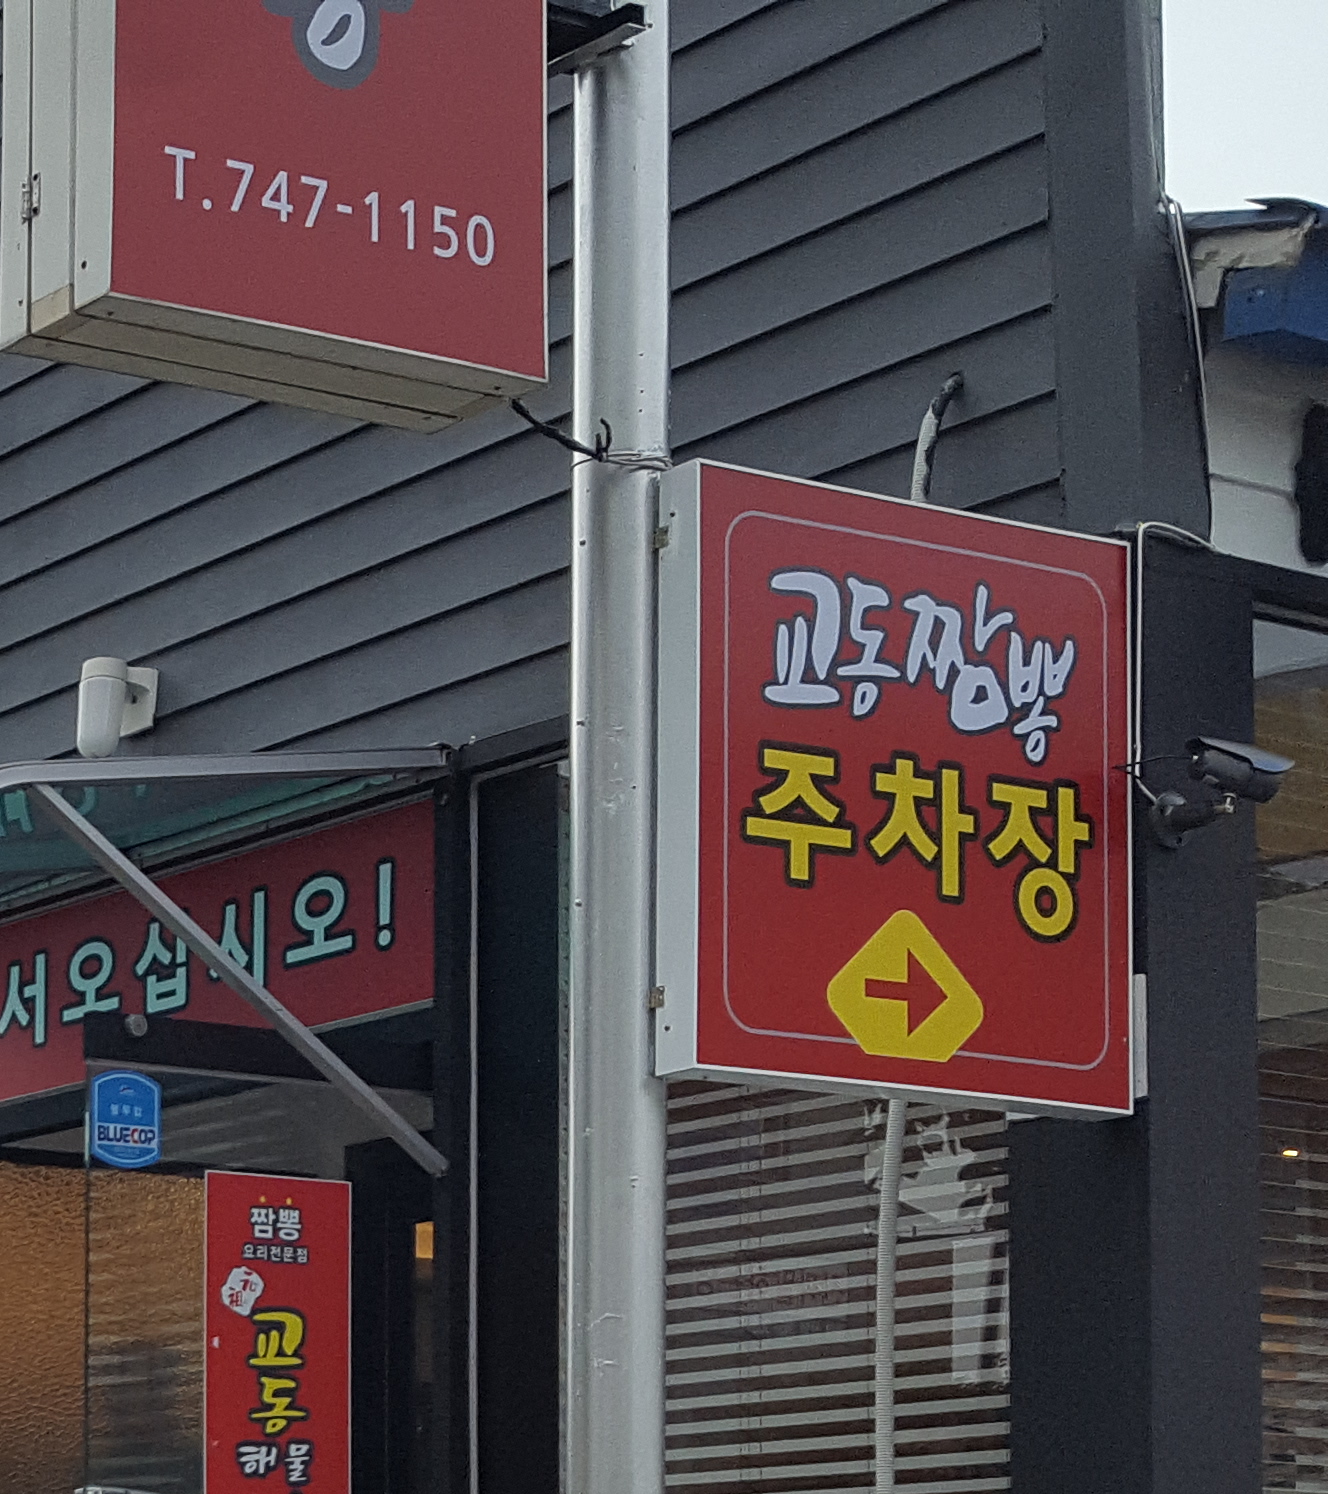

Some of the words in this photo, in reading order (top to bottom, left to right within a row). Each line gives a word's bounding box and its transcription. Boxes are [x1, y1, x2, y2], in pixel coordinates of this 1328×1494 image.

[164, 146, 494, 266] T.747-1150
[746, 747, 1089, 937] 주차장
[97, 1124, 156, 1146] BLUECOP
[242, 1244, 309, 1263] 요리전문점
